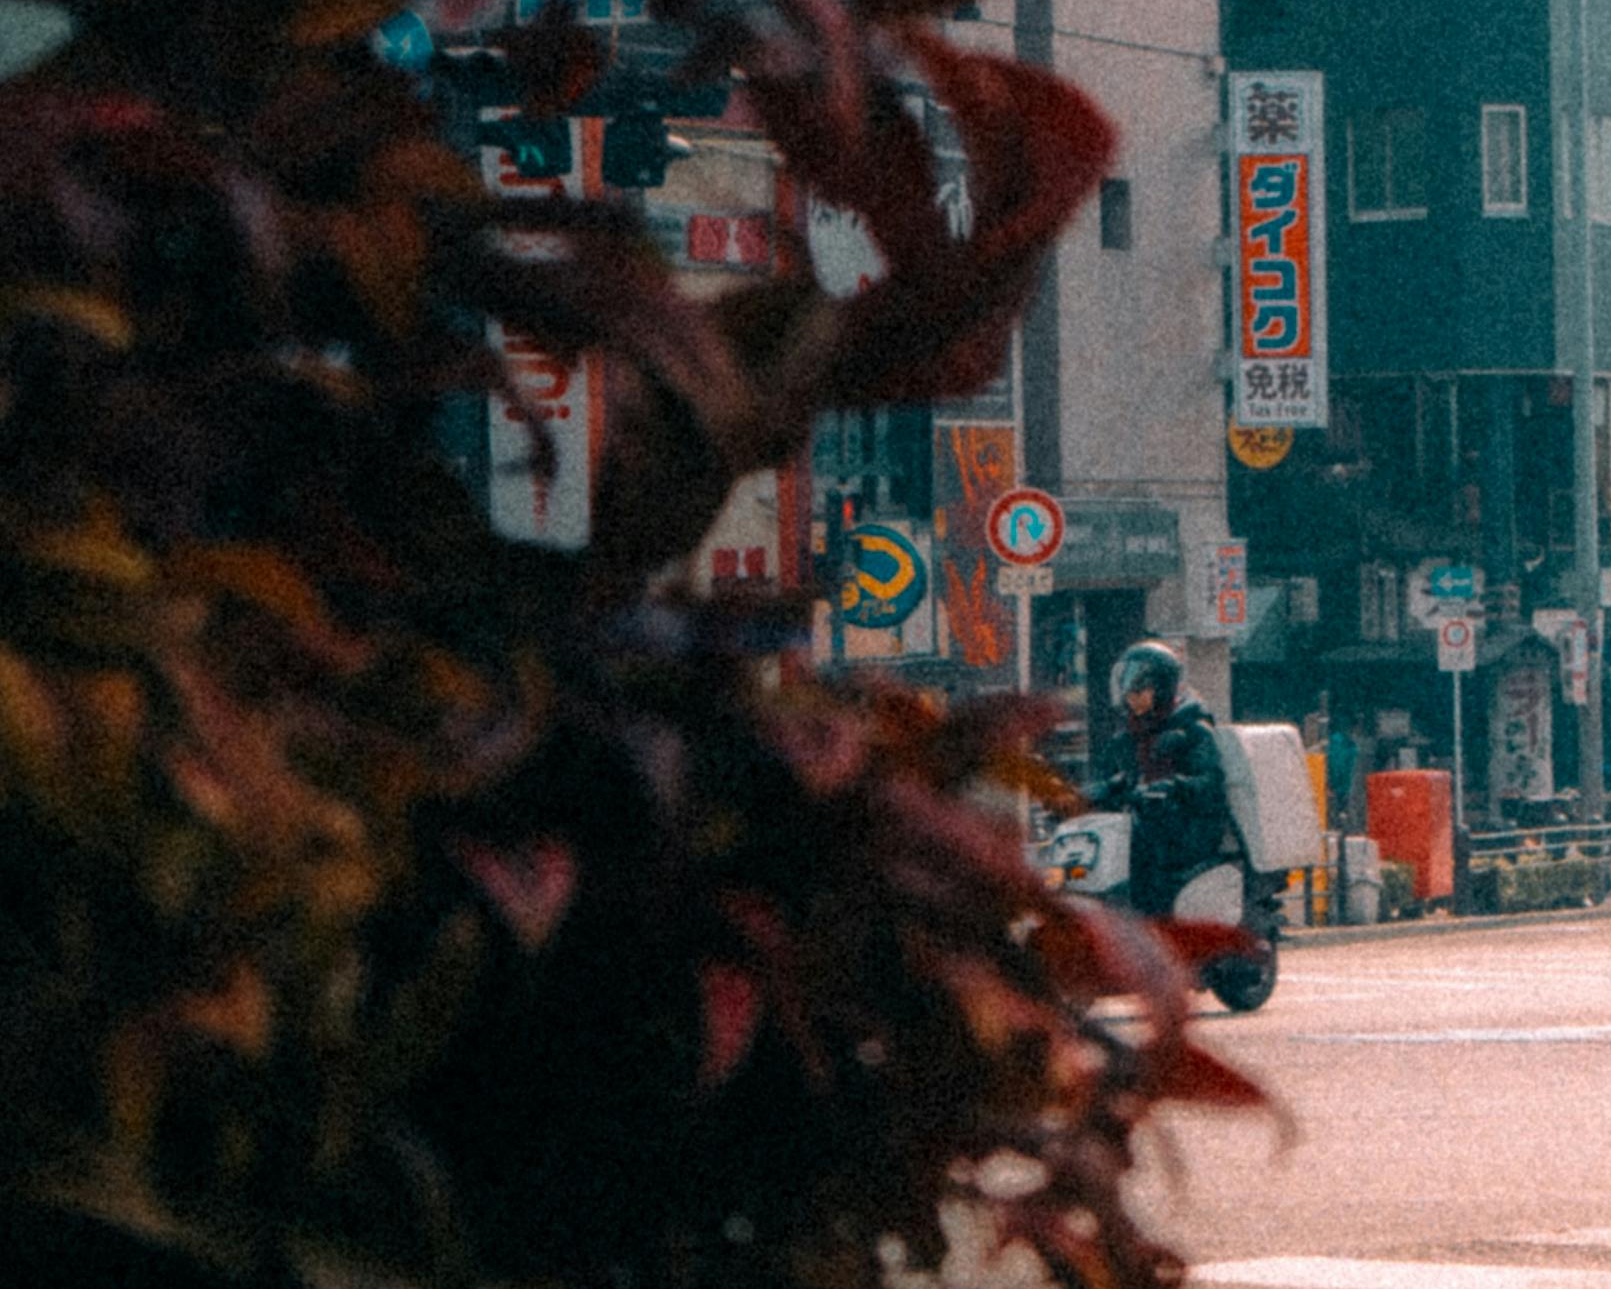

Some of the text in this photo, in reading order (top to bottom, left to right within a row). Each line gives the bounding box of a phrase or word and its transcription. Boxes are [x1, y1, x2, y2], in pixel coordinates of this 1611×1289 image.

[1247, 82, 1299, 144] 薬
[1249, 161, 1300, 351] ダイコク
[1246, 362, 1311, 401] 免税
